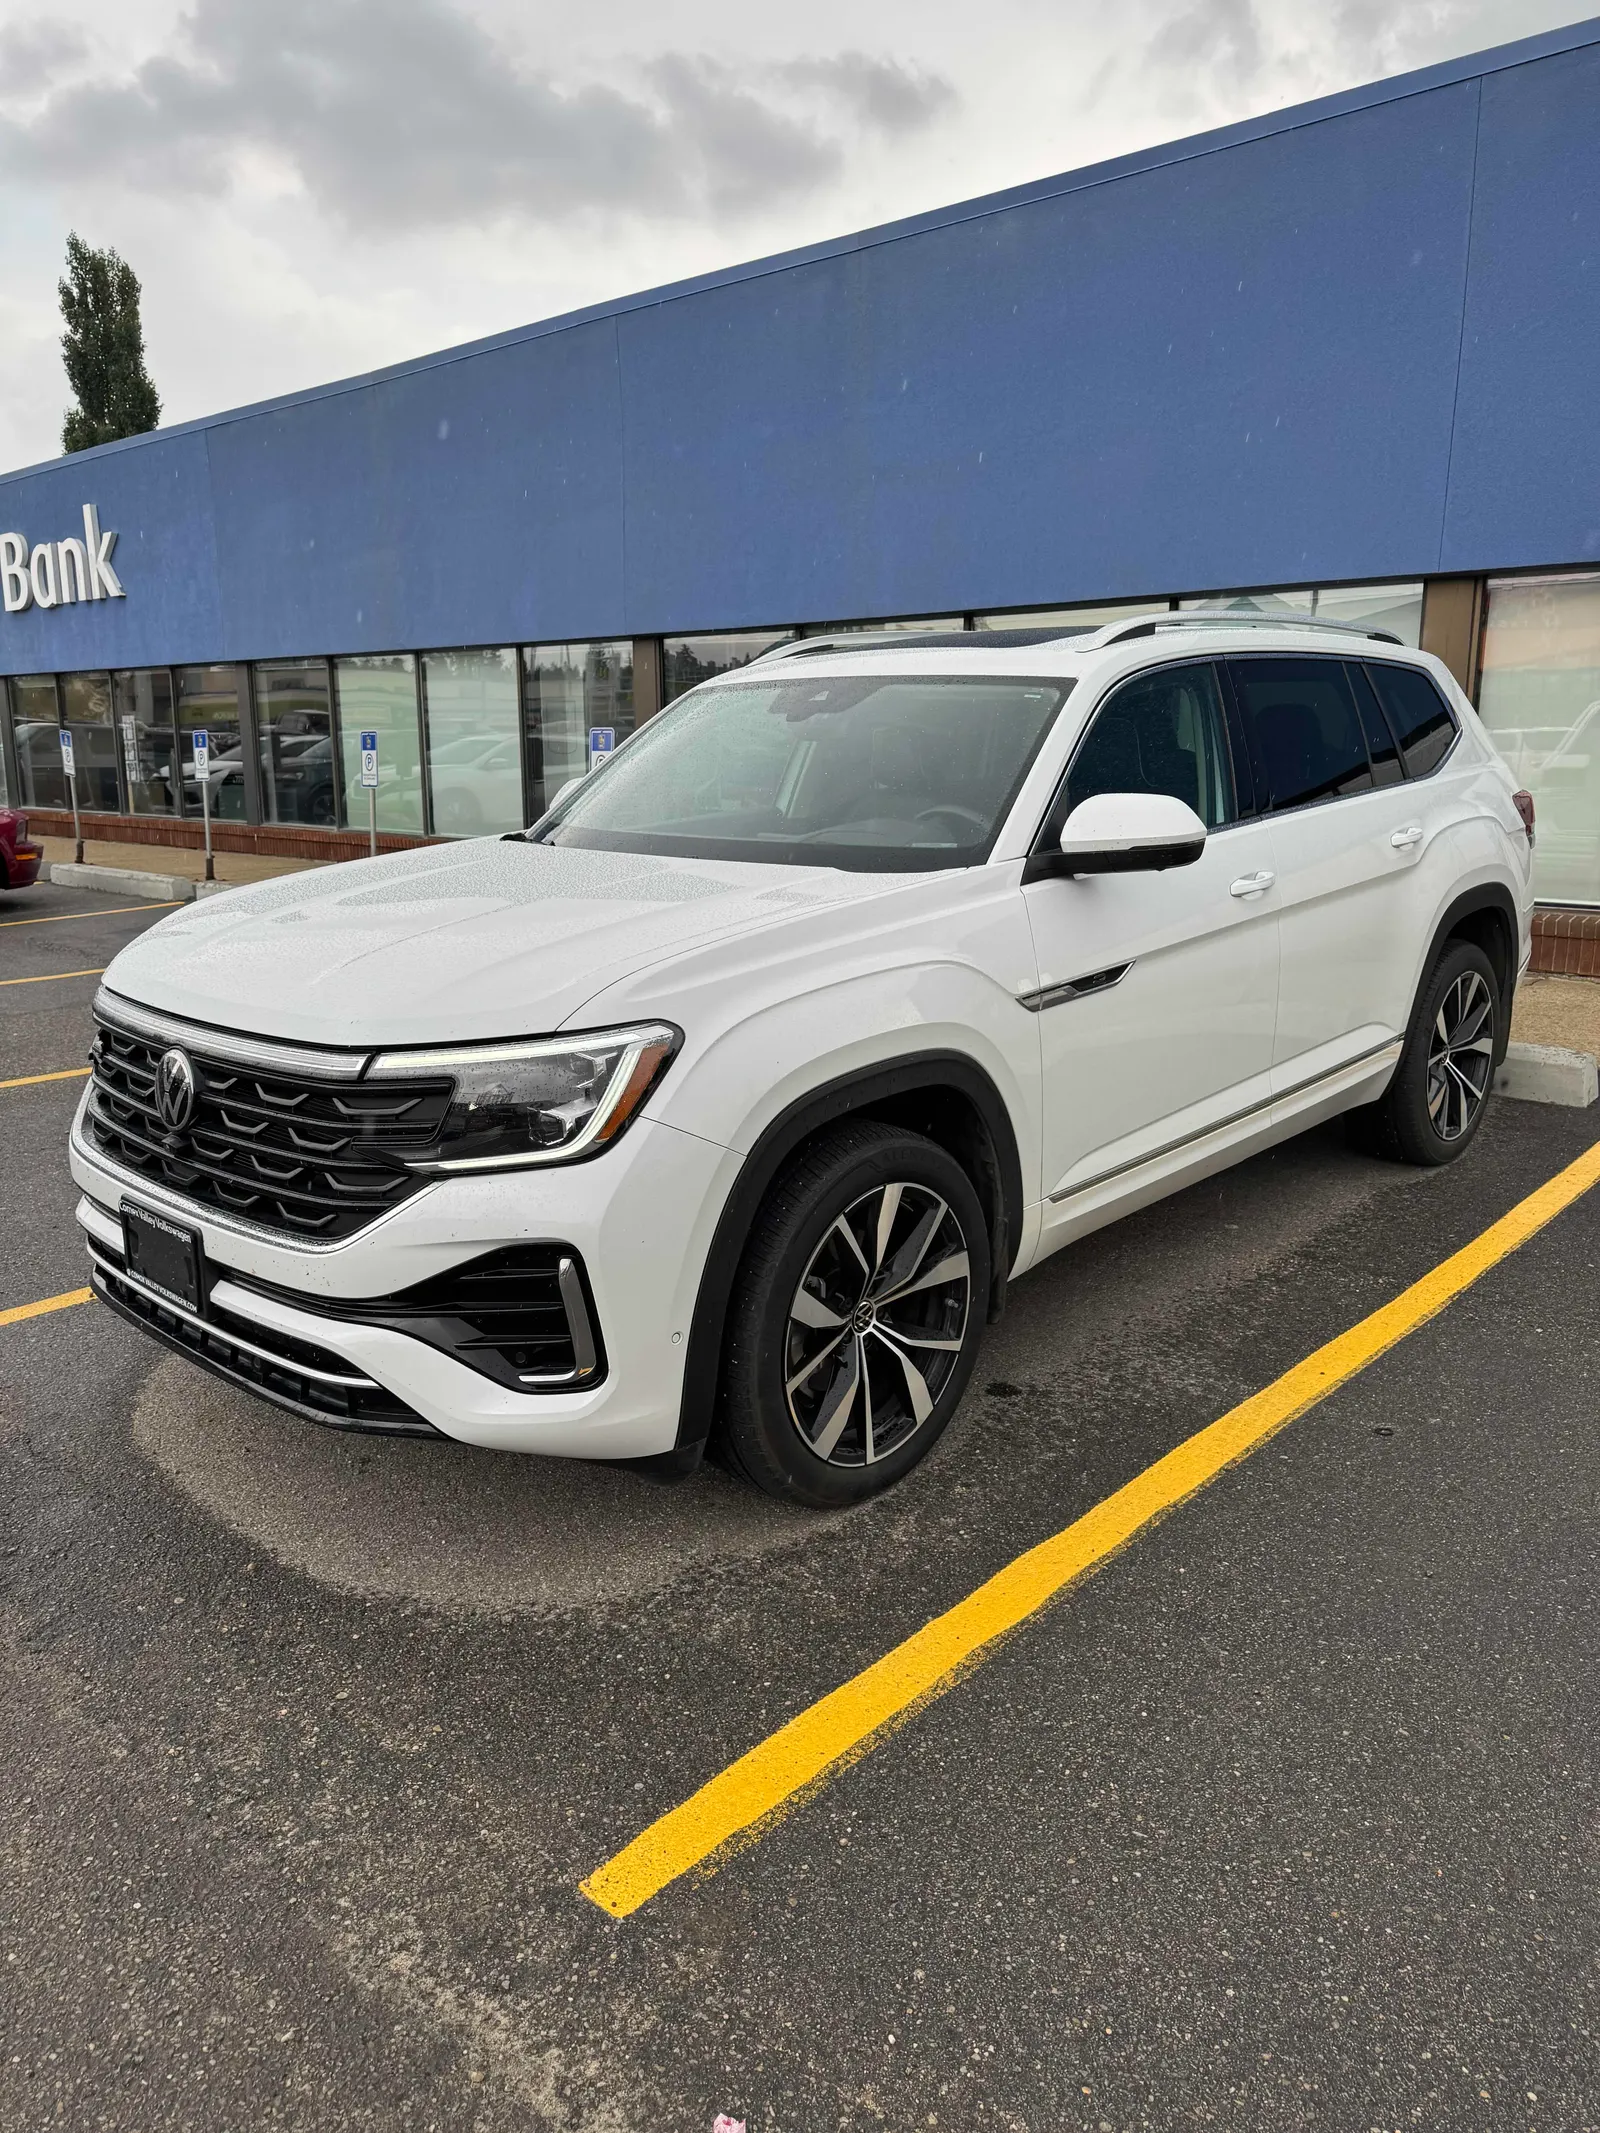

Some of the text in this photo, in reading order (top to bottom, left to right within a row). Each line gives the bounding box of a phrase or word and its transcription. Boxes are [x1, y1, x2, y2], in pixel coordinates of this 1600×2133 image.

[0, 503, 126, 612] Bank
[139, 1208, 156, 1229] Valley
[155, 1218, 192, 1244] Volkswagen
[145, 1278, 160, 1293] VALLEY
[159, 1287, 198, 1314] VOLKSWAGEN.COM
